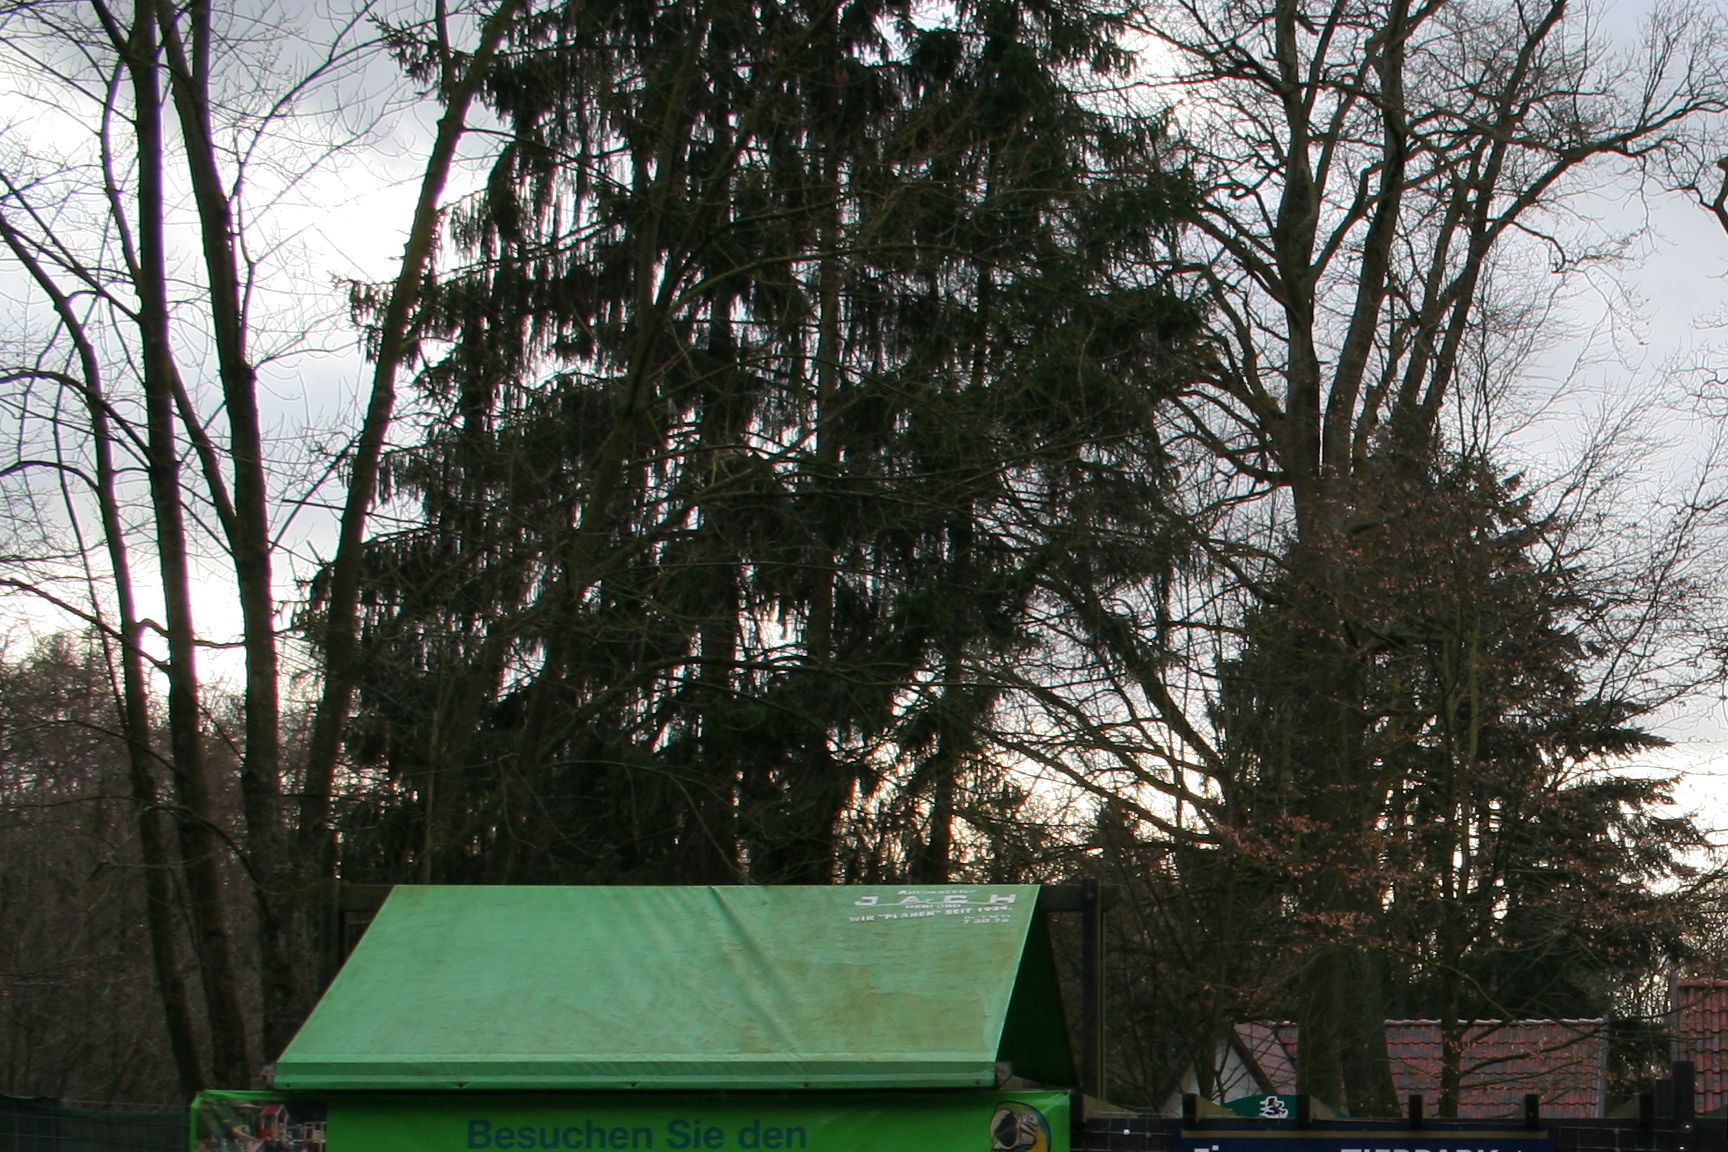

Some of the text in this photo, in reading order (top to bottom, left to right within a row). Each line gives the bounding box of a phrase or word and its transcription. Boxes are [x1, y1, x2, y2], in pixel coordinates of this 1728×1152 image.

[468, 1119, 806, 1150] Besuchen Sie den
